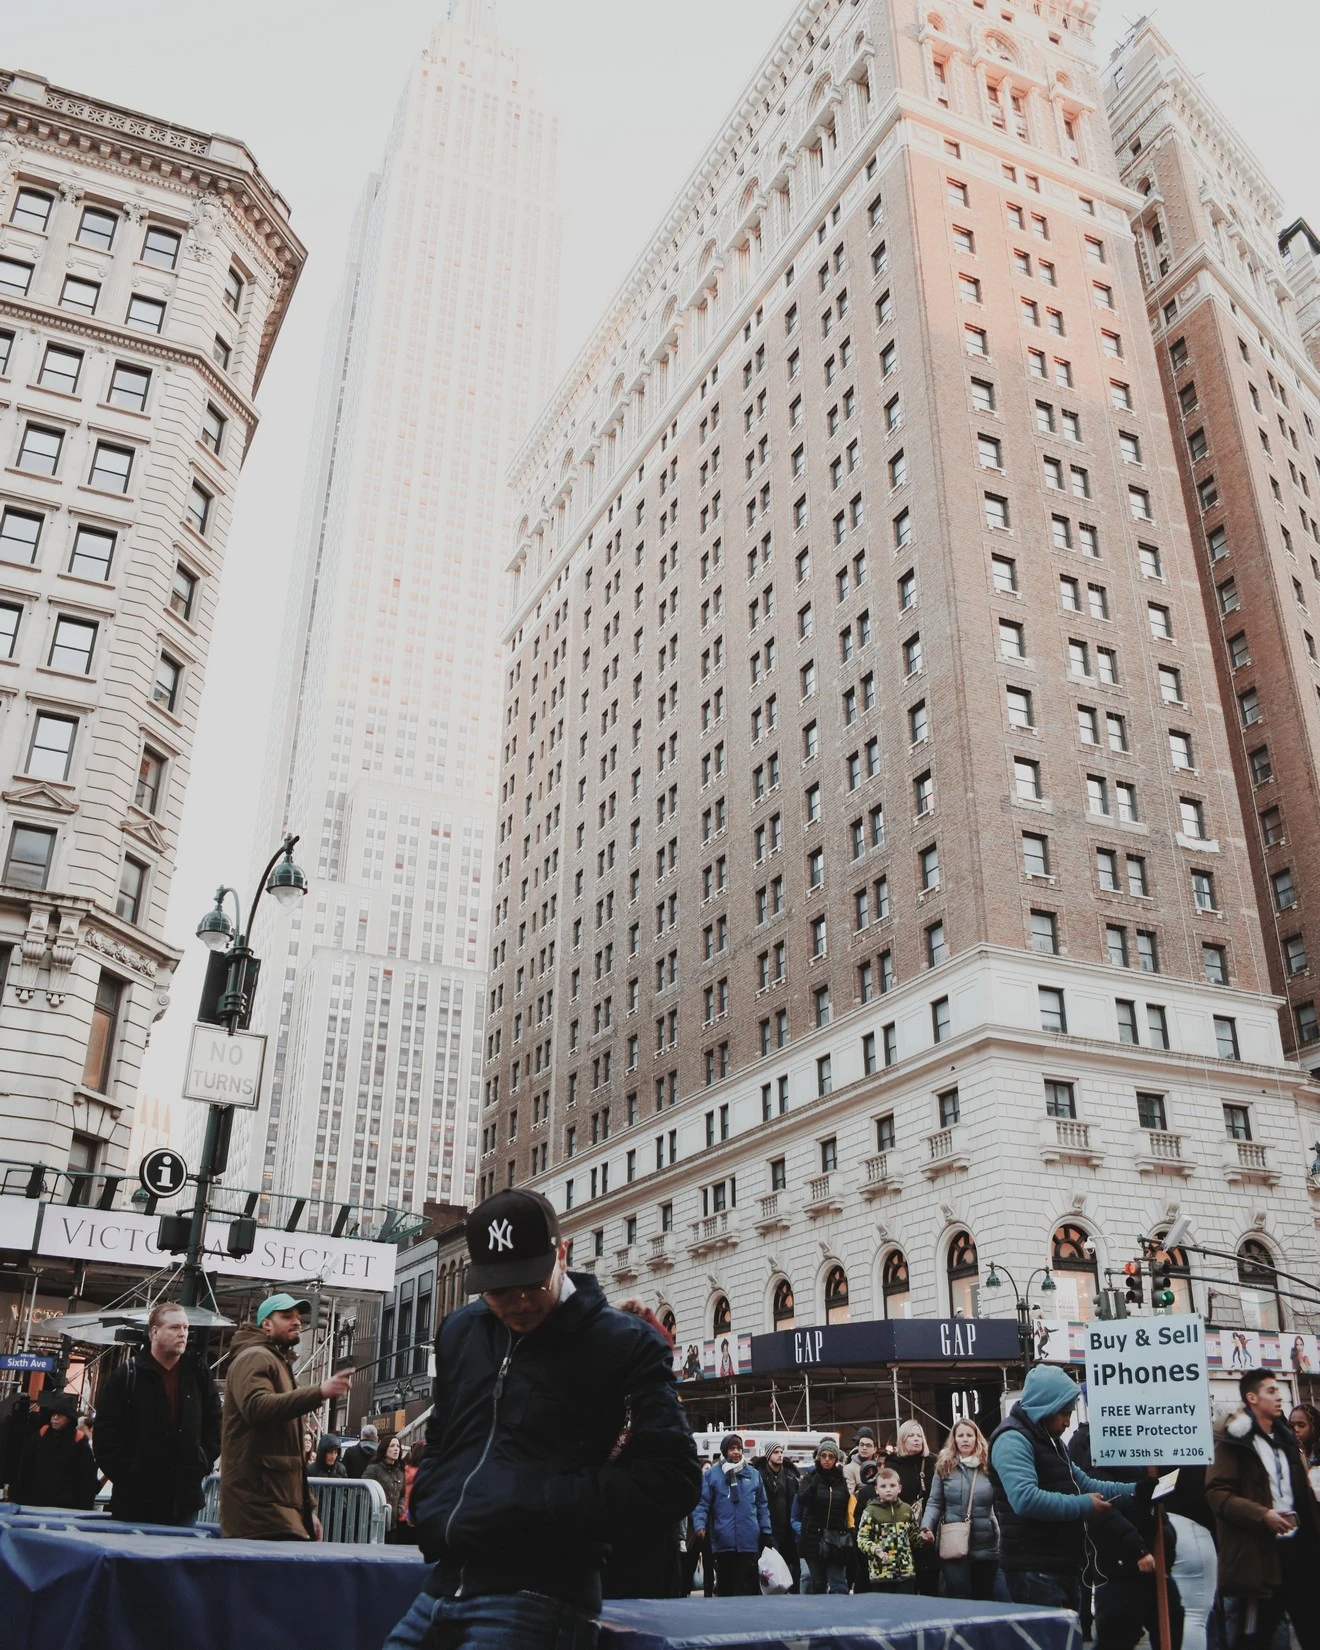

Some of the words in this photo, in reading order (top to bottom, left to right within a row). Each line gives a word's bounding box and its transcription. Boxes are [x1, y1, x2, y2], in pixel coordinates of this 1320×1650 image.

[210, 1041, 243, 1066] NO
[193, 1069, 254, 1095] TURNS
[62, 1217, 247, 1264] VICTOA
[488, 1218, 514, 1252] NY
[794, 1330, 824, 1364] GAP
[940, 1323, 976, 1356] GAP
[1090, 1333, 1127, 1353] Buy
[1135, 1328, 1152, 1347] &
[1158, 1324, 1199, 1345] Sell
[7, 1358, 29, 1367] Sixth
[30, 1359, 47, 1368] Ave
[1093, 1362, 1200, 1386] iPhones
[1101, 1405, 1131, 1417] FREE
[1135, 1403, 1196, 1416] Warranty
[1102, 1426, 1132, 1437] FREE
[1136, 1424, 1198, 1437] Protector
[1100, 1449, 1116, 1458] 147
[1118, 1449, 1127, 1458] W
[1130, 1448, 1151, 1458] 35th
[1154, 1448, 1164, 1457] St
[1172, 1447, 1205, 1457] #1206
